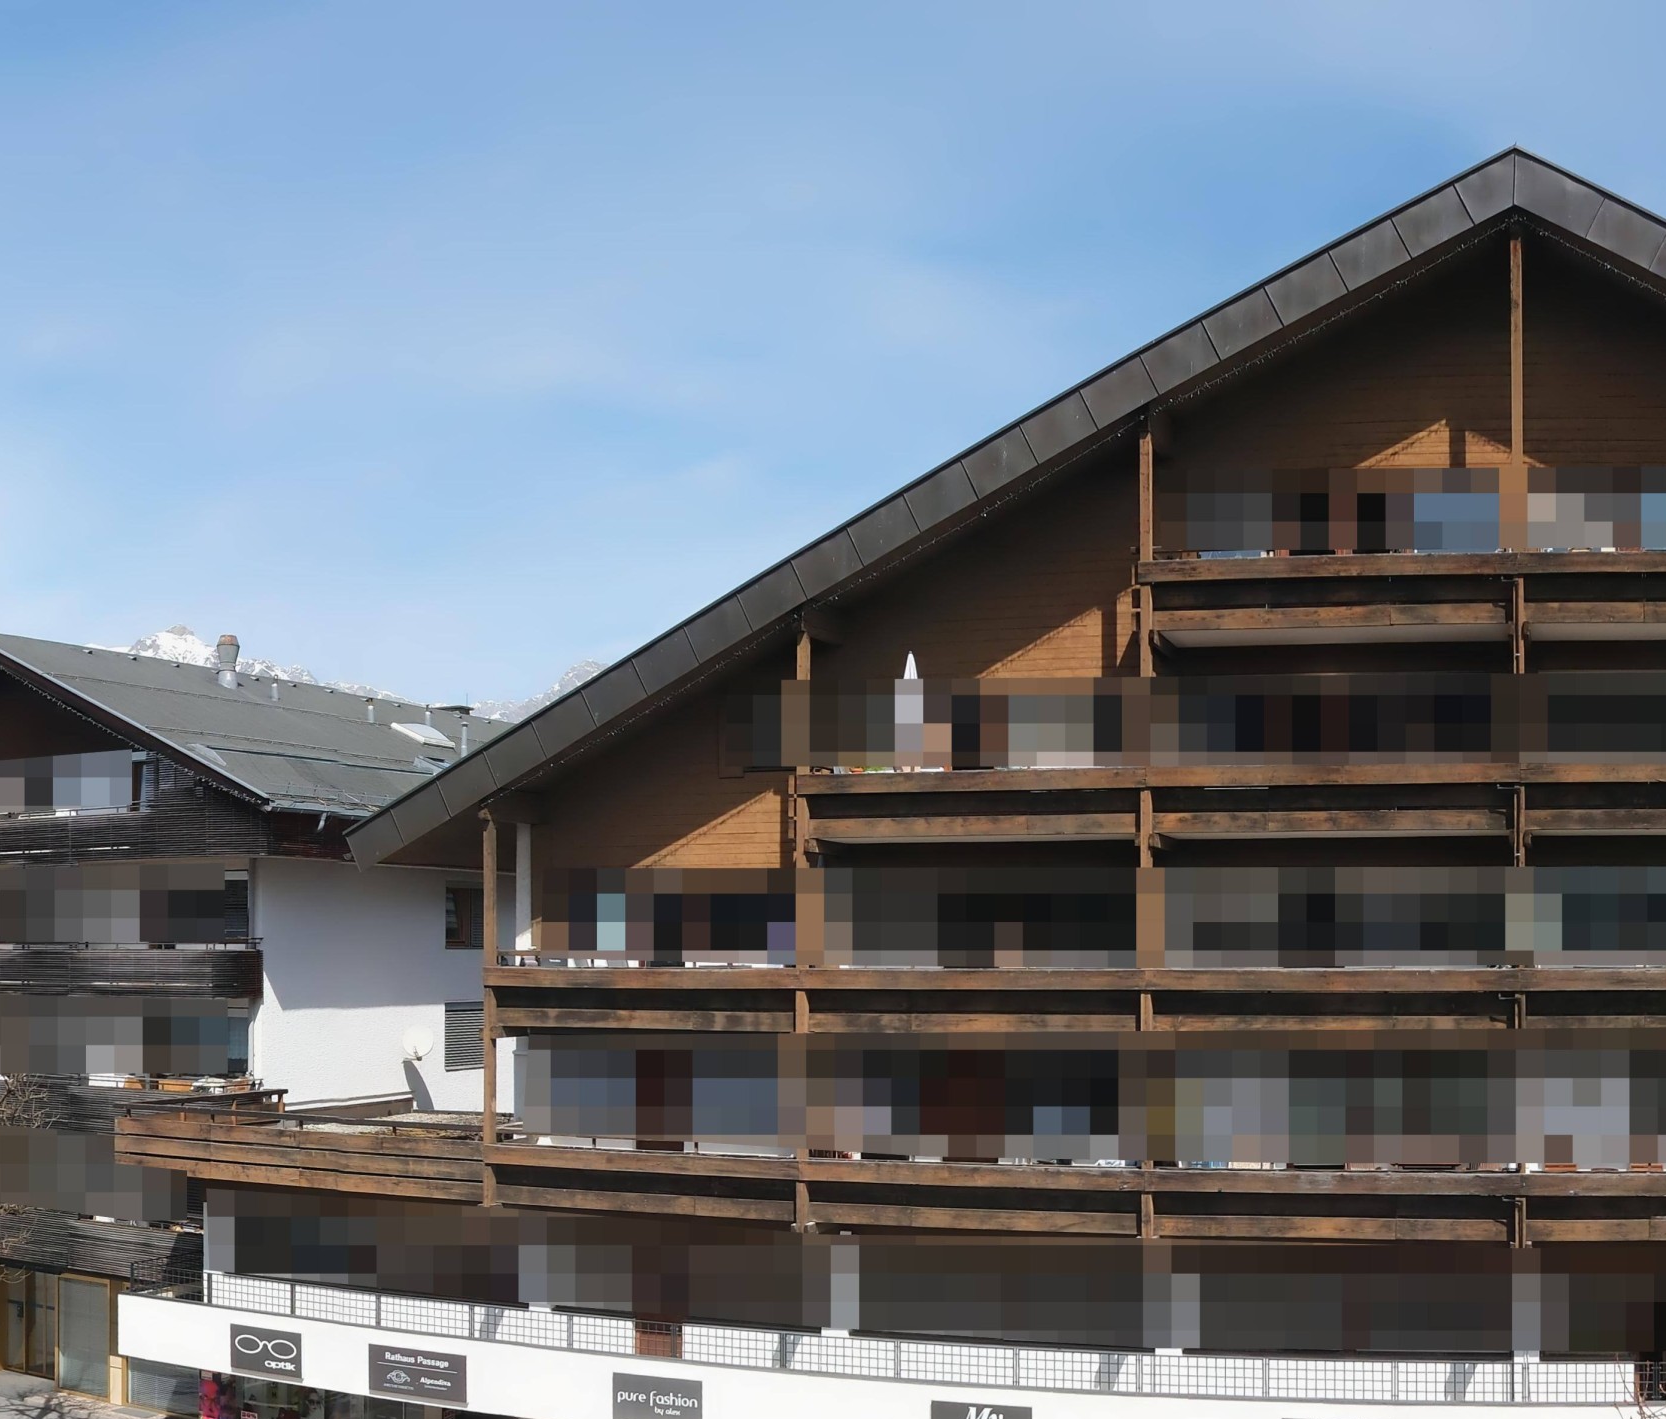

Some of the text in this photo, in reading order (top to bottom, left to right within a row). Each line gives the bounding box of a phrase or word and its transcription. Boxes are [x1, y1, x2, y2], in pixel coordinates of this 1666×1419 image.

[264, 1359, 296, 1371] optik
[385, 1351, 449, 1369] Rathaus Passage
[617, 1390, 698, 1408] pure fashion
[654, 1406, 681, 1416] by alex
